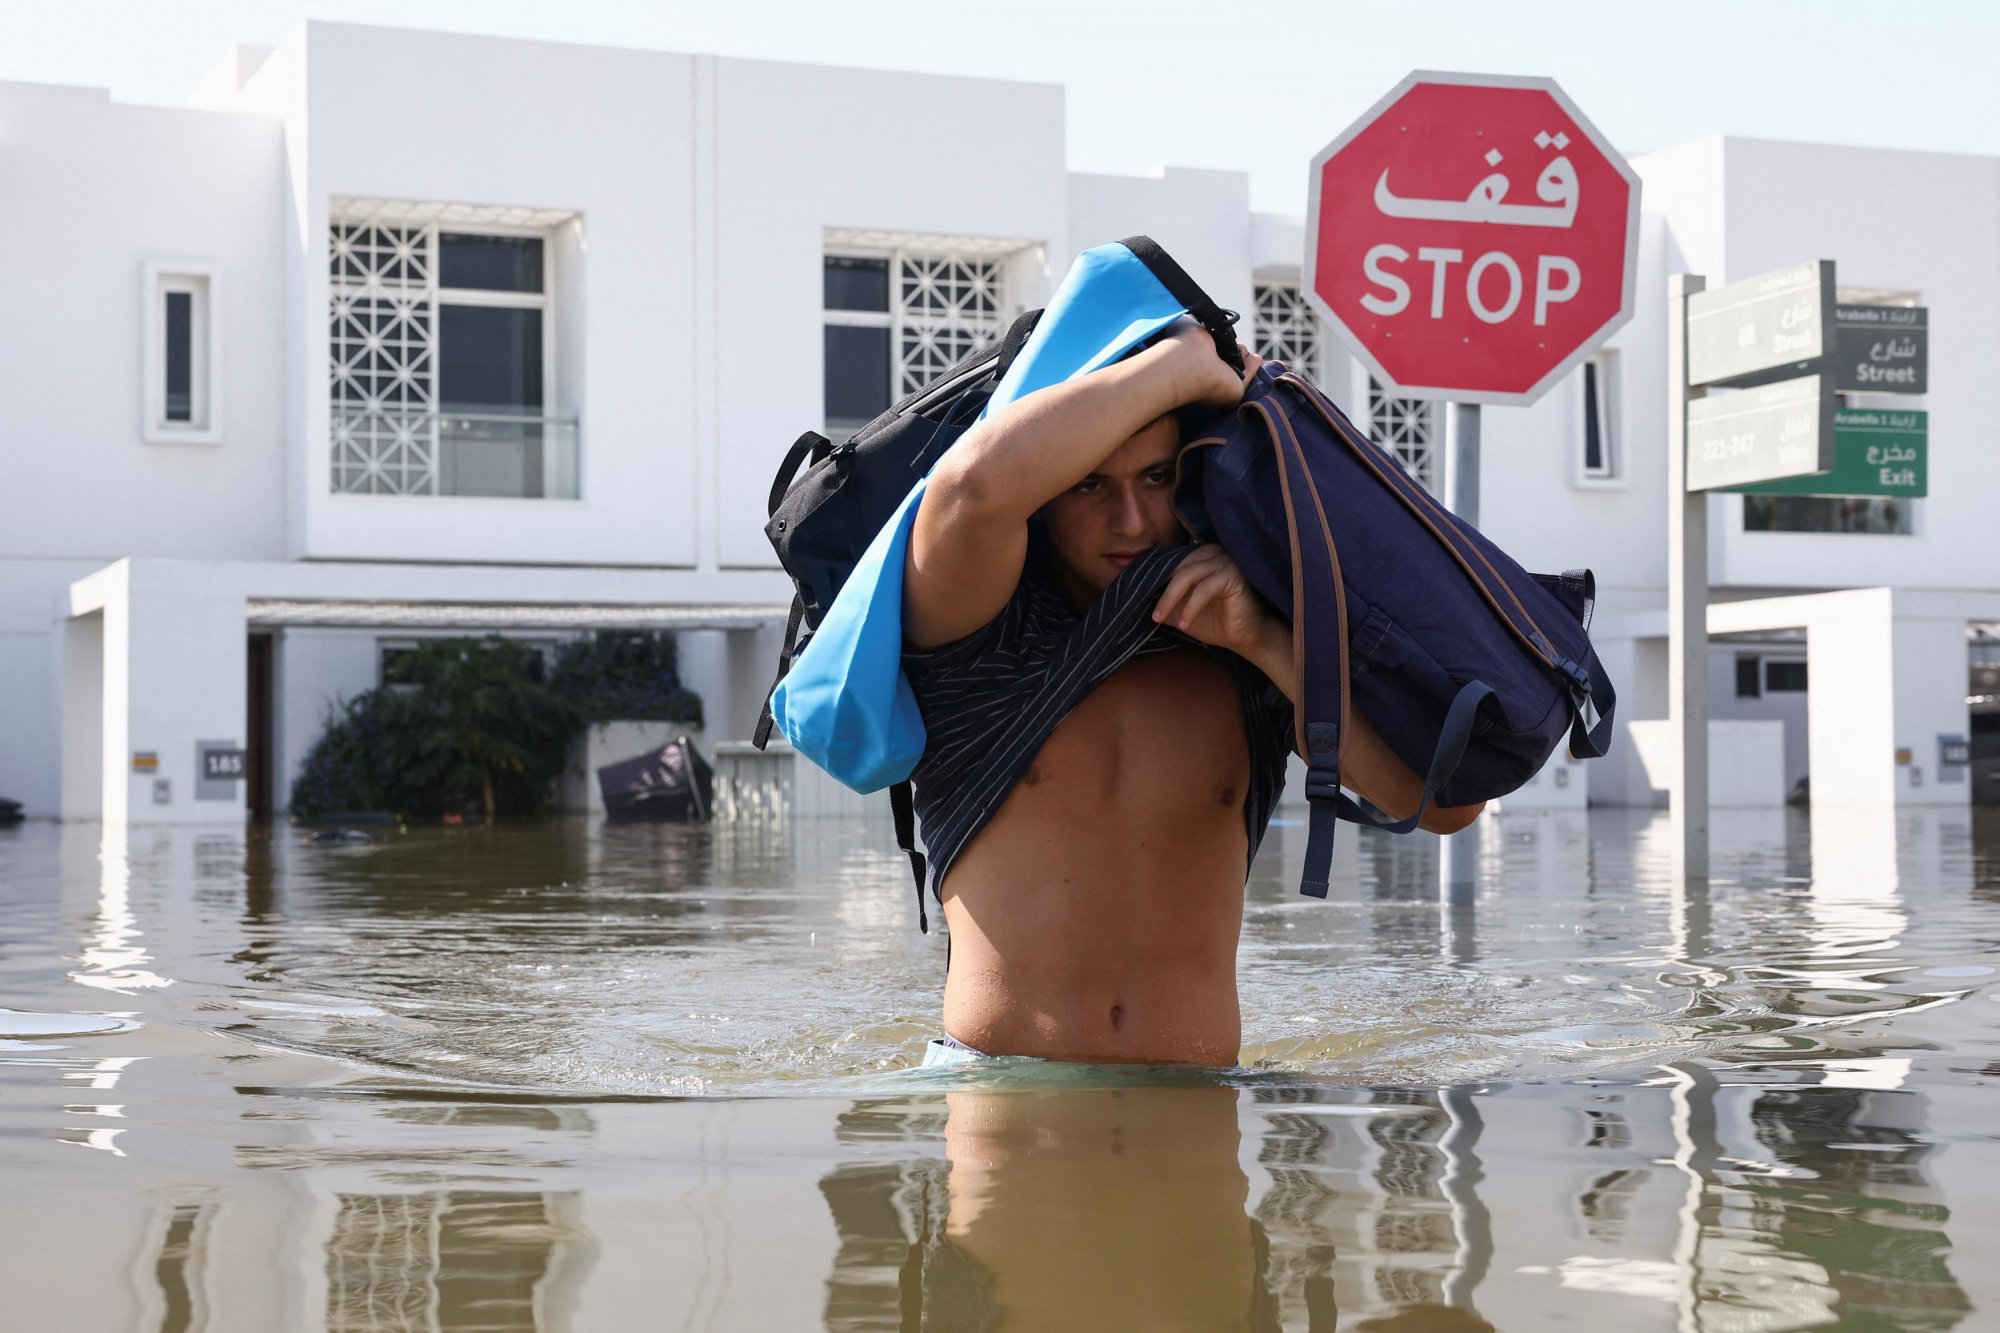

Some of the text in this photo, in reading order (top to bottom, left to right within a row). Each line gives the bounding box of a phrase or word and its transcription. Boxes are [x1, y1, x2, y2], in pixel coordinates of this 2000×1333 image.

[1374, 130, 1580, 228] قف
[1359, 243, 1582, 326] STOP
[1781, 296, 1813, 329] شارع
[1774, 328, 1813, 353] Street
[1869, 336, 1917, 363] شارع
[1856, 363, 1917, 383] Street
[1834, 412, 1880, 425] Arabella
[1866, 442, 1917, 465] مخرج
[1879, 467, 1917, 487] Exit
